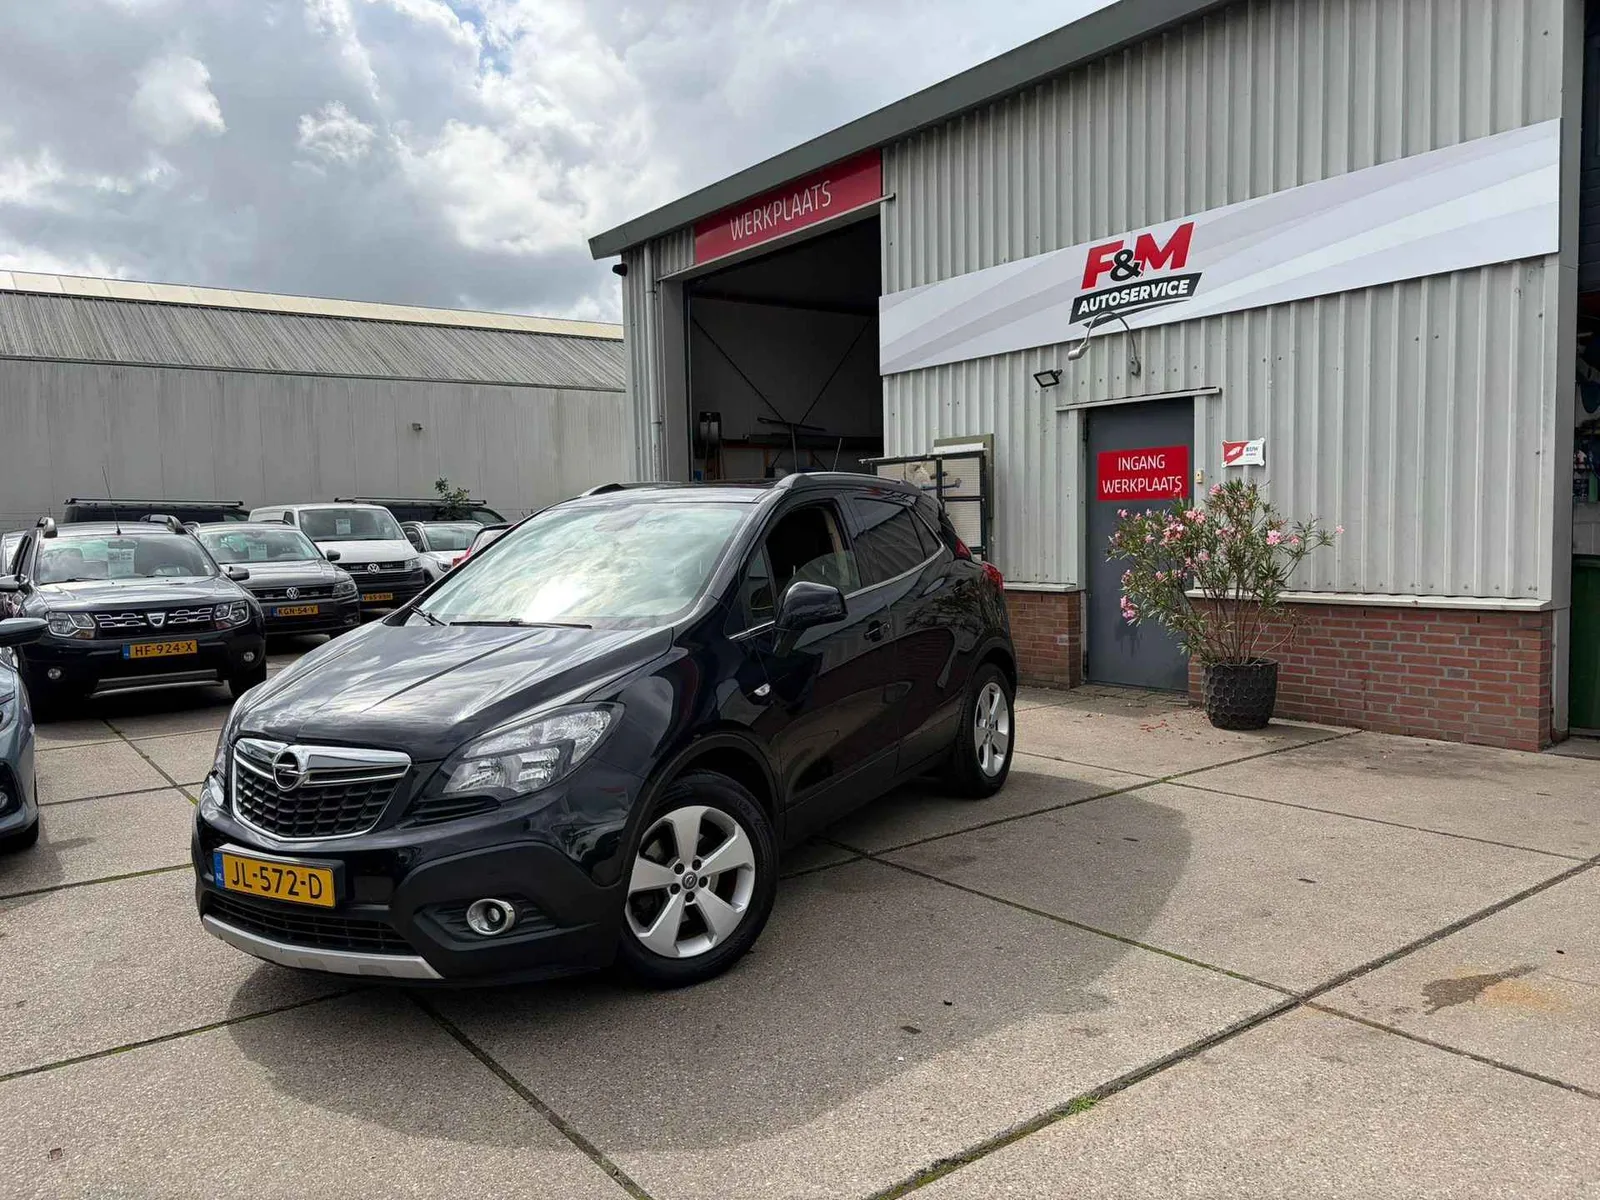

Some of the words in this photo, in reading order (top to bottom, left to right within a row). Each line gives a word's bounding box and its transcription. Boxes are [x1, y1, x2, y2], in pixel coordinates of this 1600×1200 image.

[730, 180, 832, 241] WERKPLAATS
[1081, 221, 1195, 290] F&M
[1078, 280, 1190, 315] AUTOSERVICE
[1118, 454, 1166, 471] INGANG
[1102, 476, 1183, 494] WERKPLAATS
[135, 642, 193, 656] HF-924-X
[232, 861, 323, 899] JL-572-D
